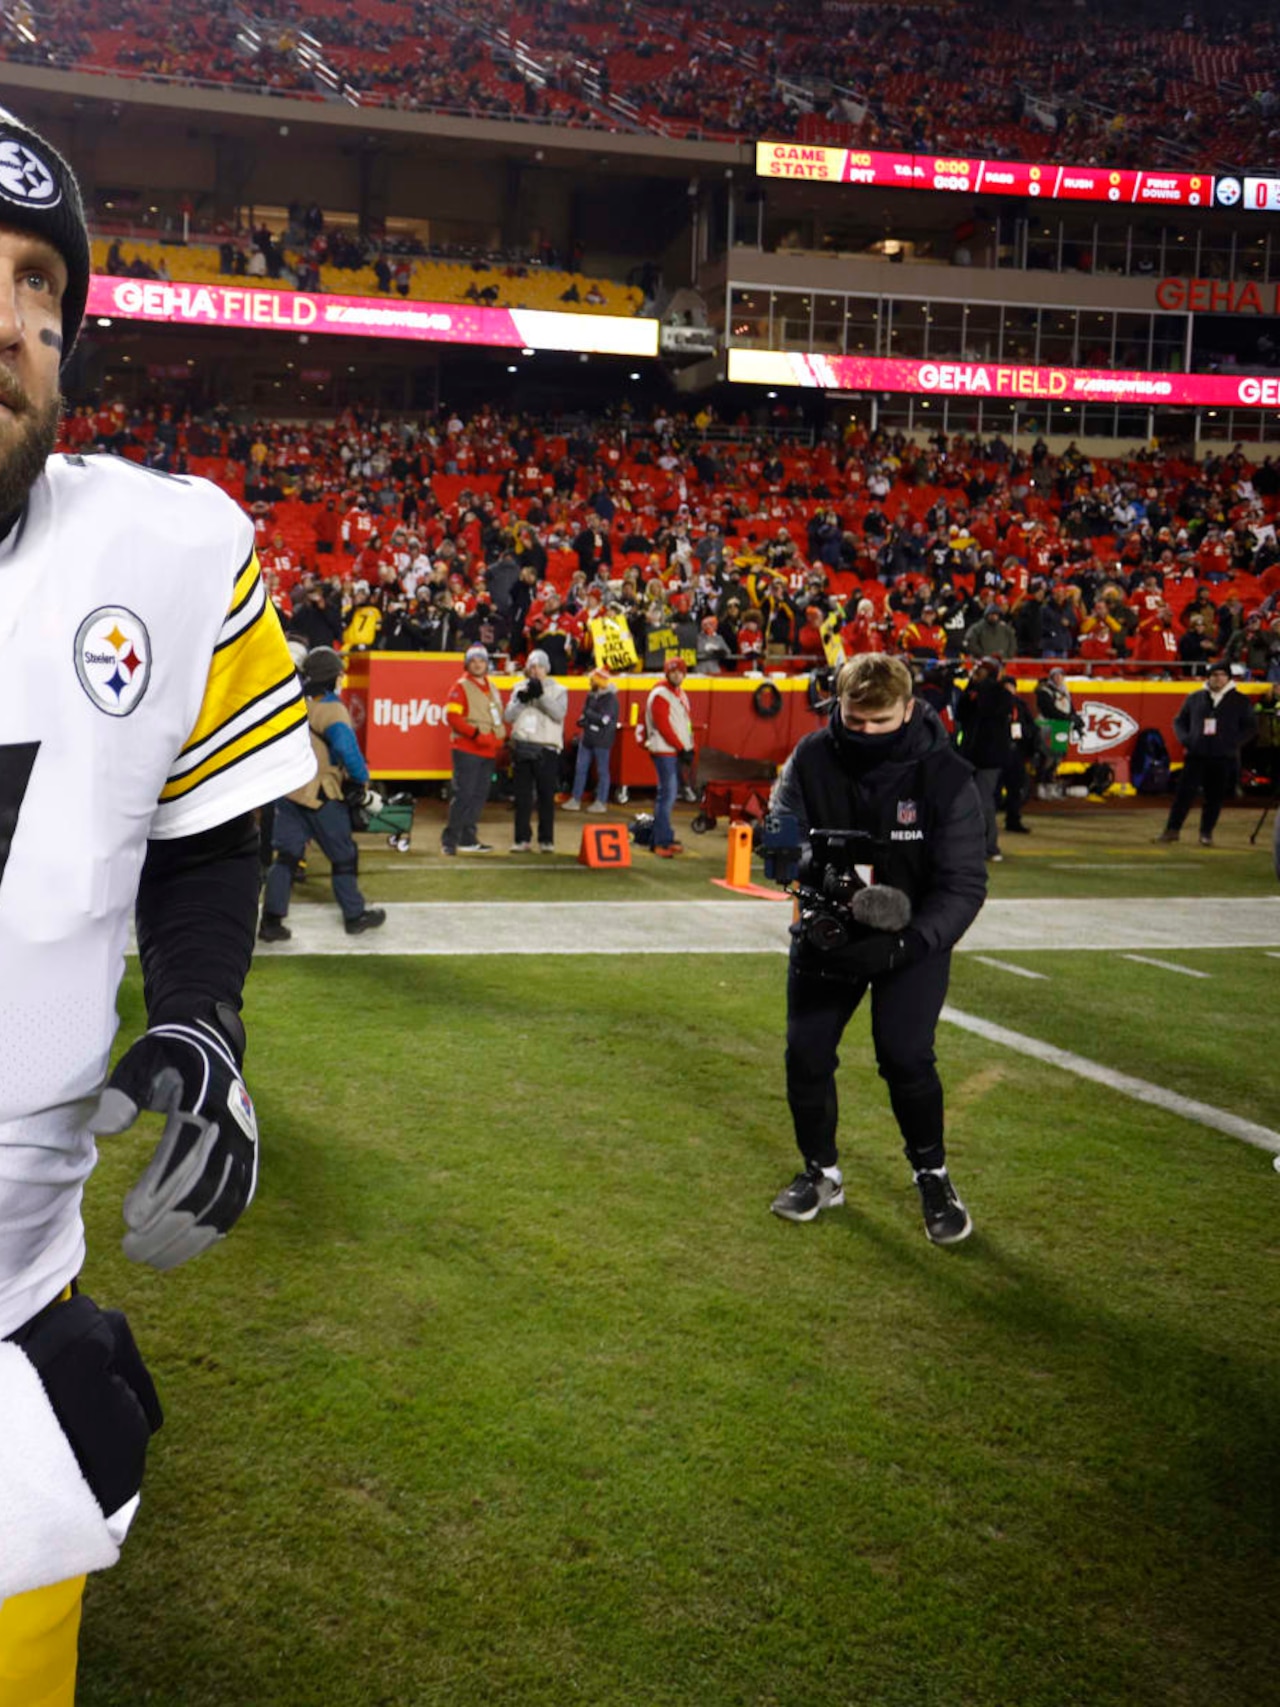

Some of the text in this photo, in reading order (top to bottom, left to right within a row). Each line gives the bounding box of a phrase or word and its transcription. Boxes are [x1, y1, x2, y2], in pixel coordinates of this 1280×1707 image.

[773, 147, 826, 162] GAME
[770, 161, 829, 178] STATS
[934, 160, 969, 175] 0:00
[1029, 167, 1041, 181] 0
[850, 169, 875, 183] PIT
[933, 176, 969, 191] 0:00
[1109, 172, 1120, 185] 0
[1190, 177, 1201, 190] 0
[1028, 182, 1041, 196] 0
[1108, 187, 1120, 201] 0
[1256, 182, 1268, 209] 0
[1188, 192, 1200, 206] 0
[1155, 277, 1263, 314] GEHA
[114, 282, 218, 319] GEHA
[220, 289, 317, 325] FIELD
[918, 363, 991, 391] GEHA
[996, 369, 1067, 395] FIELD
[358, 615, 368, 632] 7
[85, 651, 115, 664] Steelers
[1087, 714, 1121, 740] KC
[890, 830, 924, 841] MEDIA
[595, 829, 621, 862] G
